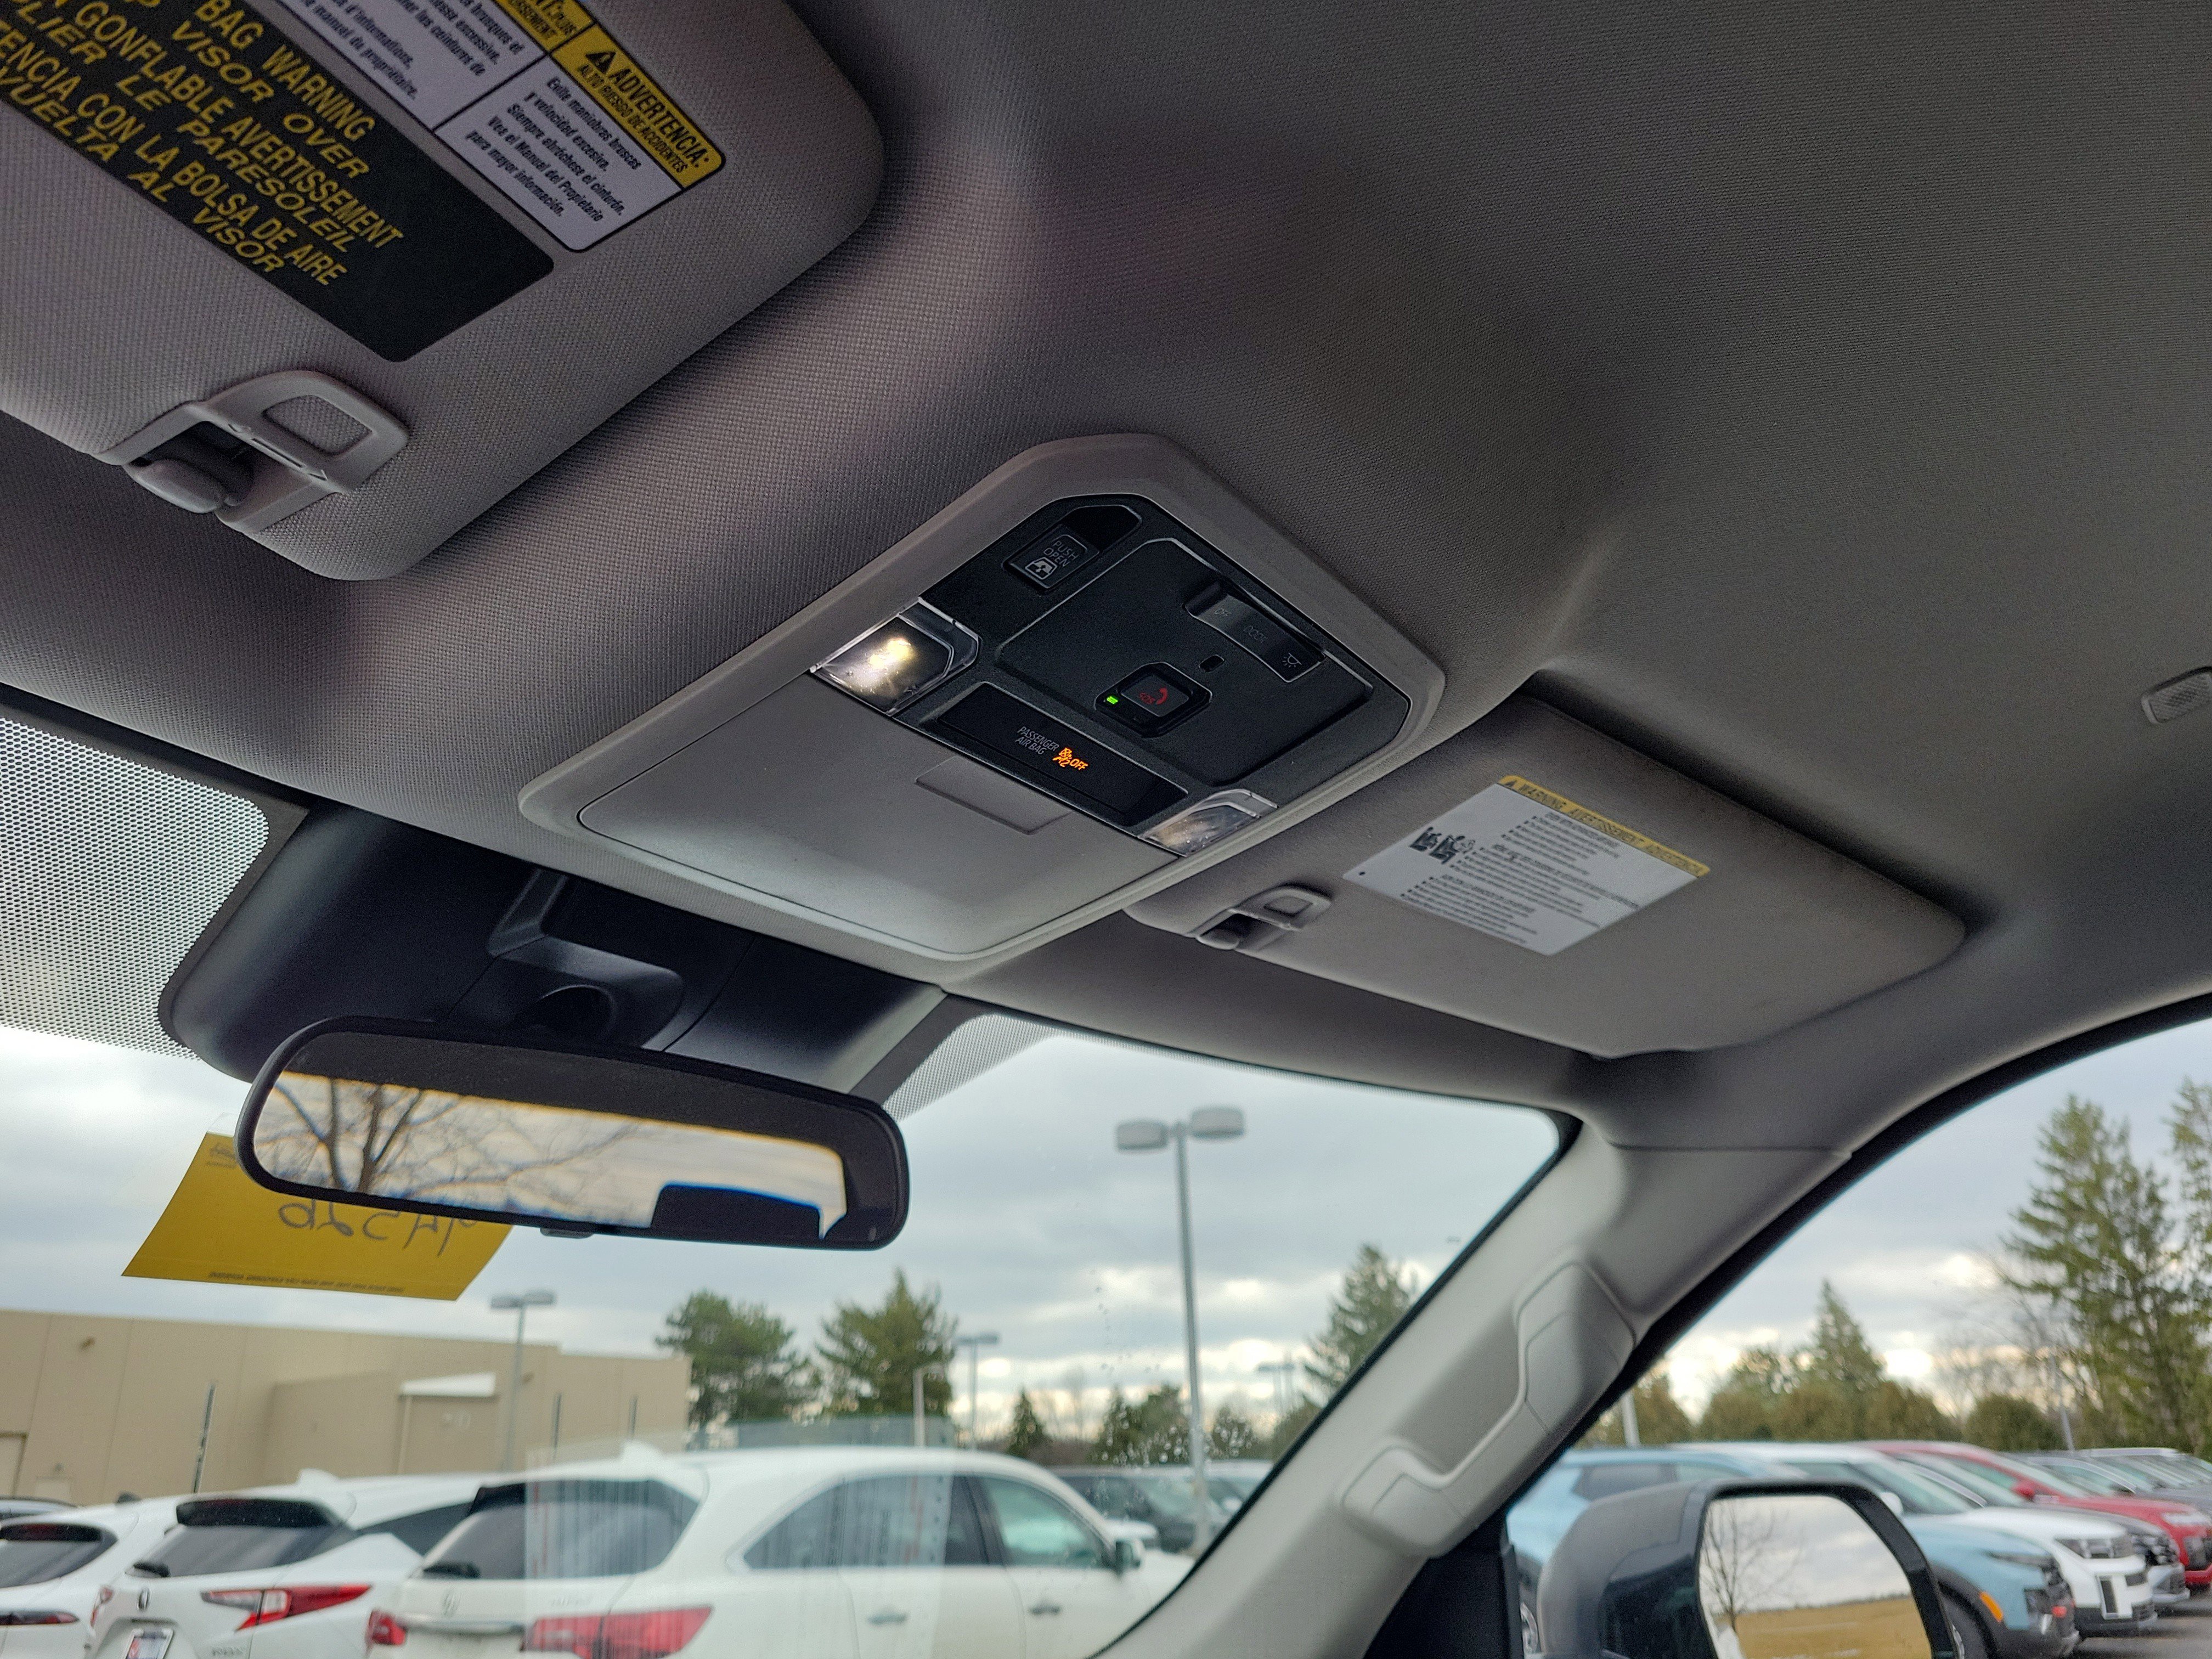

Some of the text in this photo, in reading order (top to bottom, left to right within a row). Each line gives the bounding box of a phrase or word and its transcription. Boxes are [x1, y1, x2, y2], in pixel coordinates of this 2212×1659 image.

[11, 0, 354, 252] LIER LE PARESOLEIL
[75, 2, 403, 248] GONFLABLE AVERTISSEMENT
[172, 20, 369, 179] VISOR OVER
[195, 0, 375, 141] BAG WARNING
[0, 66, 285, 273] VUELTA AL VISOR
[77, 92, 146, 143] CON
[135, 133, 180, 171] LA
[172, 160, 259, 227] BOLSA
[251, 218, 297, 251] DE
[284, 244, 348, 285] AIRE
[1043, 548, 1070, 567] OPEN
[1052, 540, 1080, 560] PUSH
[1015, 736, 1047, 755] AIR BAG
[1017, 725, 1060, 752] PASSENGER
[1069, 758, 1088, 770] OFF
